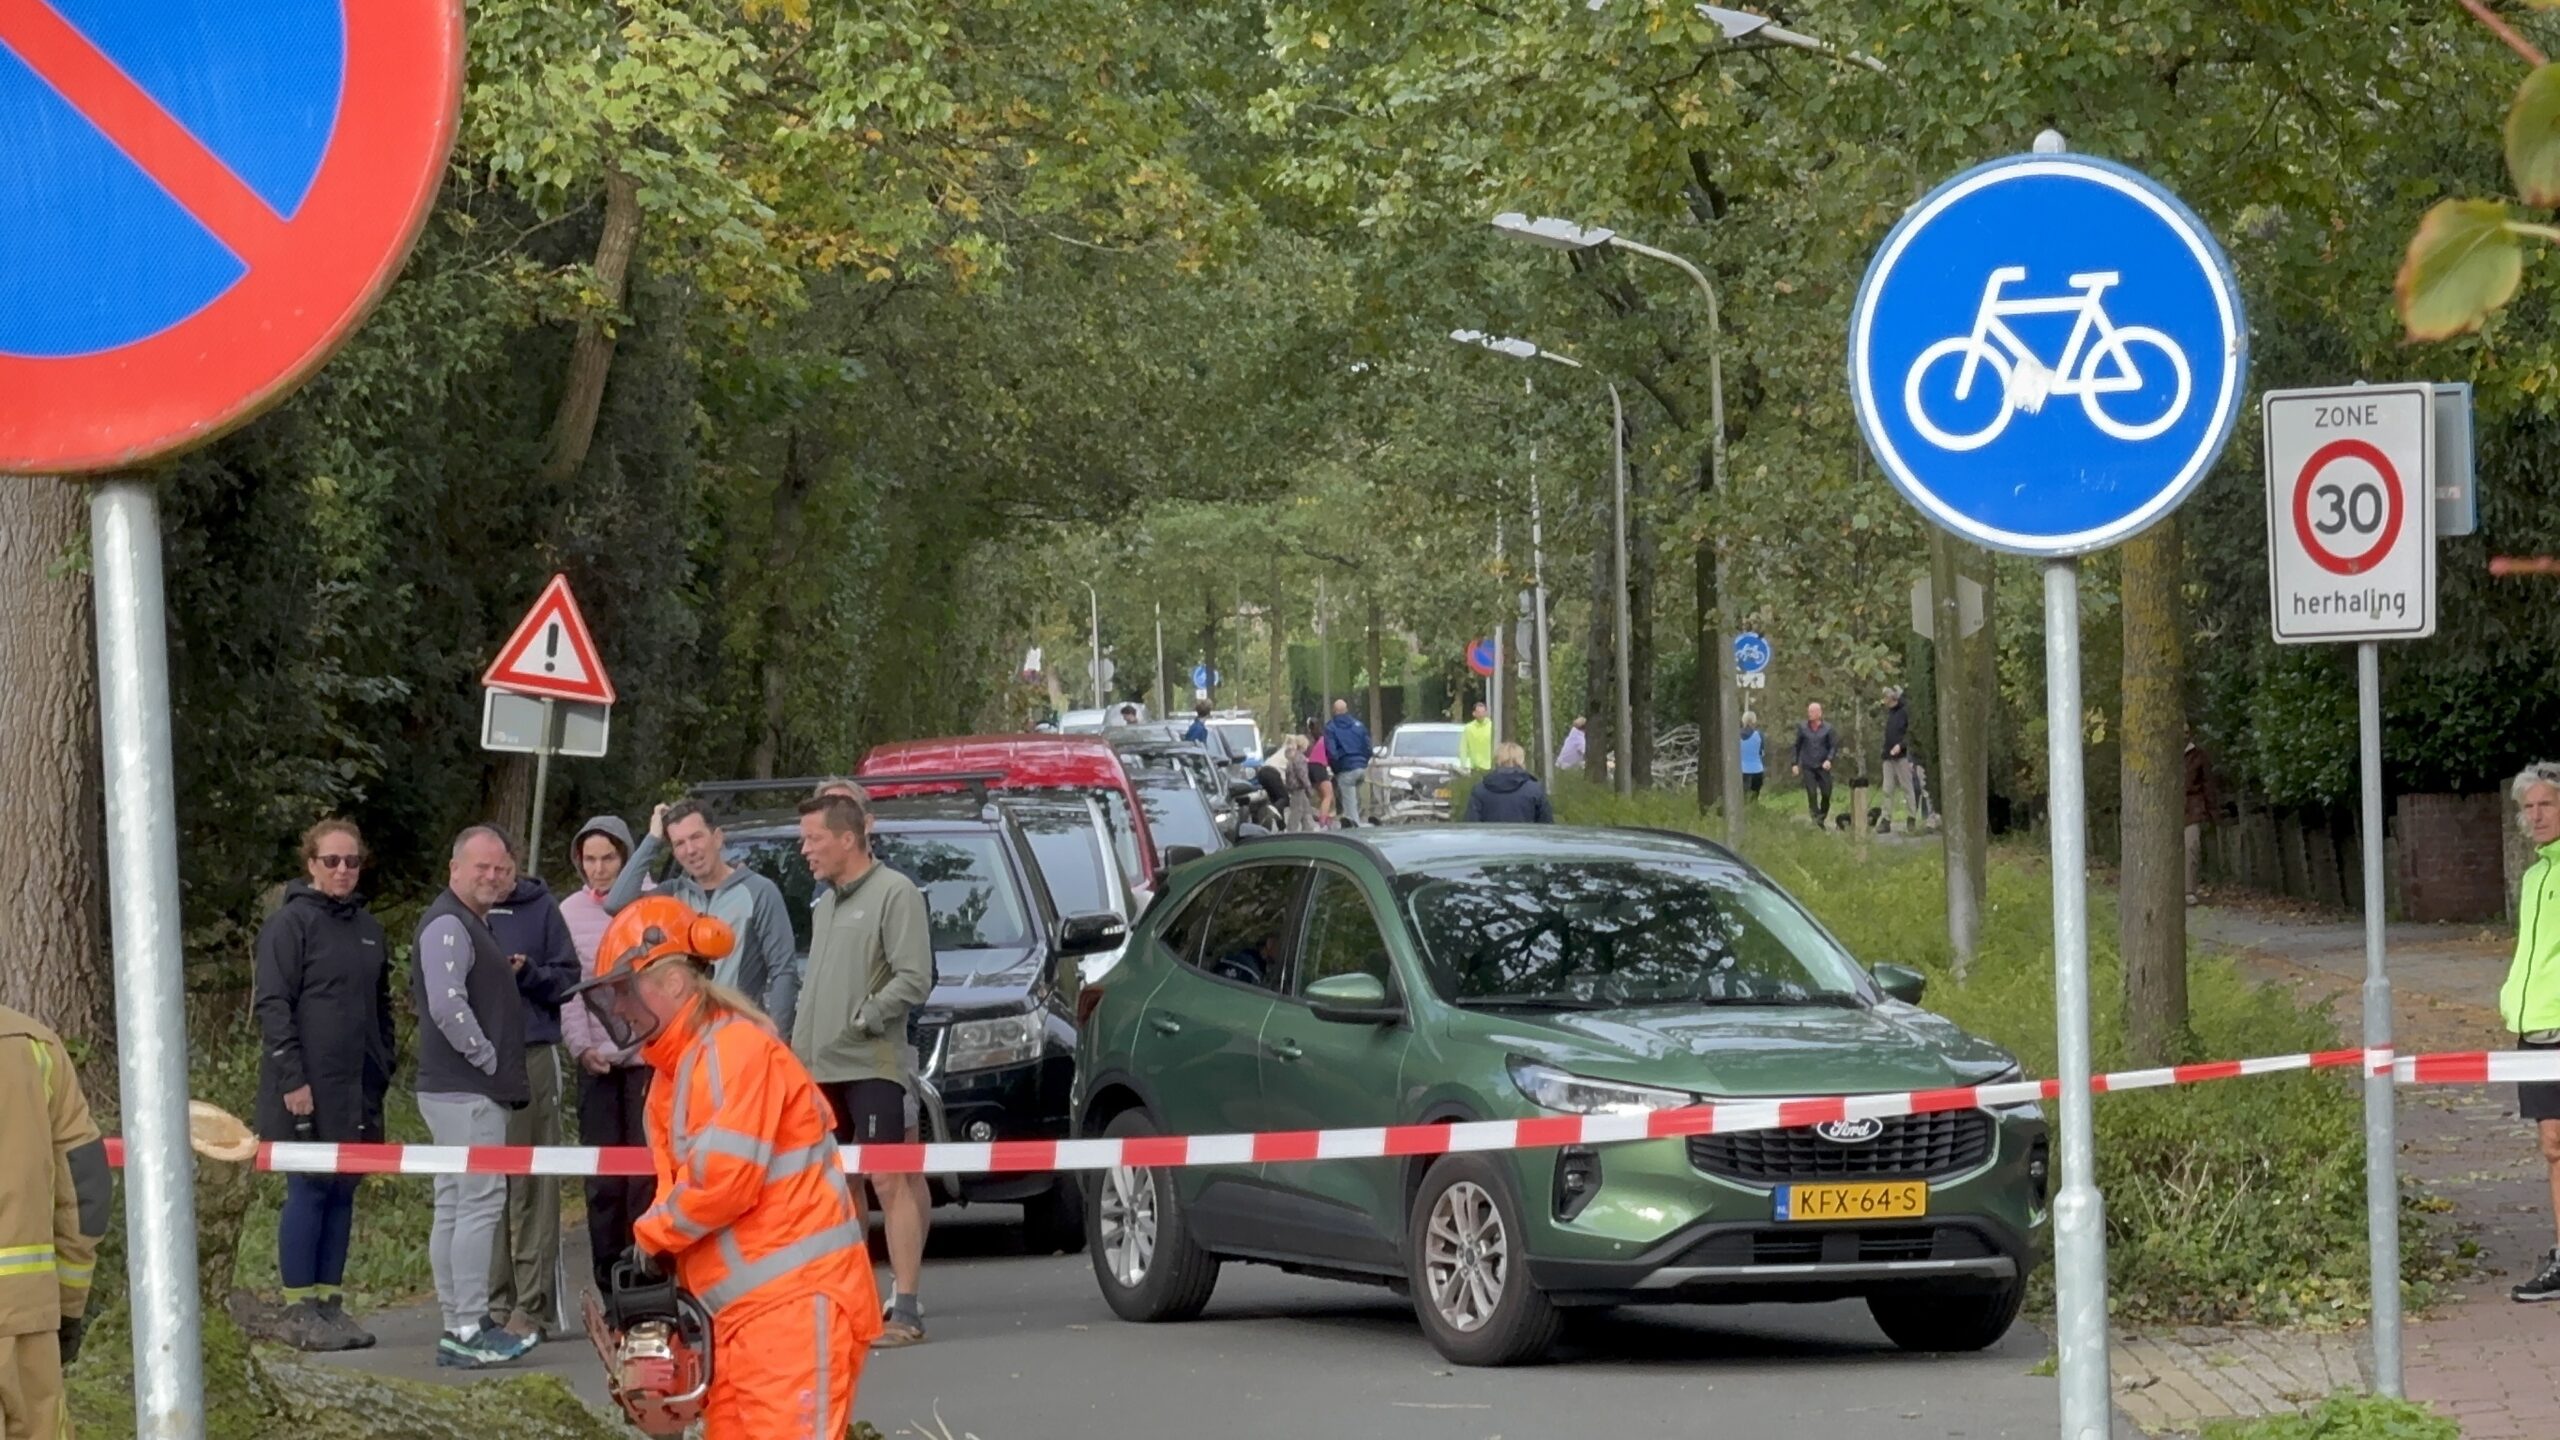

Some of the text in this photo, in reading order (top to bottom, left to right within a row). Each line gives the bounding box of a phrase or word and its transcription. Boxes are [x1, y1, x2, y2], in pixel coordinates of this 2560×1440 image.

[2314, 405, 2378, 428] ZONE
[2314, 483, 2383, 535] 30
[2293, 588, 2406, 618] herhaling
[1829, 1120, 1871, 1137] Ford
[1777, 1205, 1788, 1214] NL
[1801, 1187, 1917, 1214] KFX-64-S
